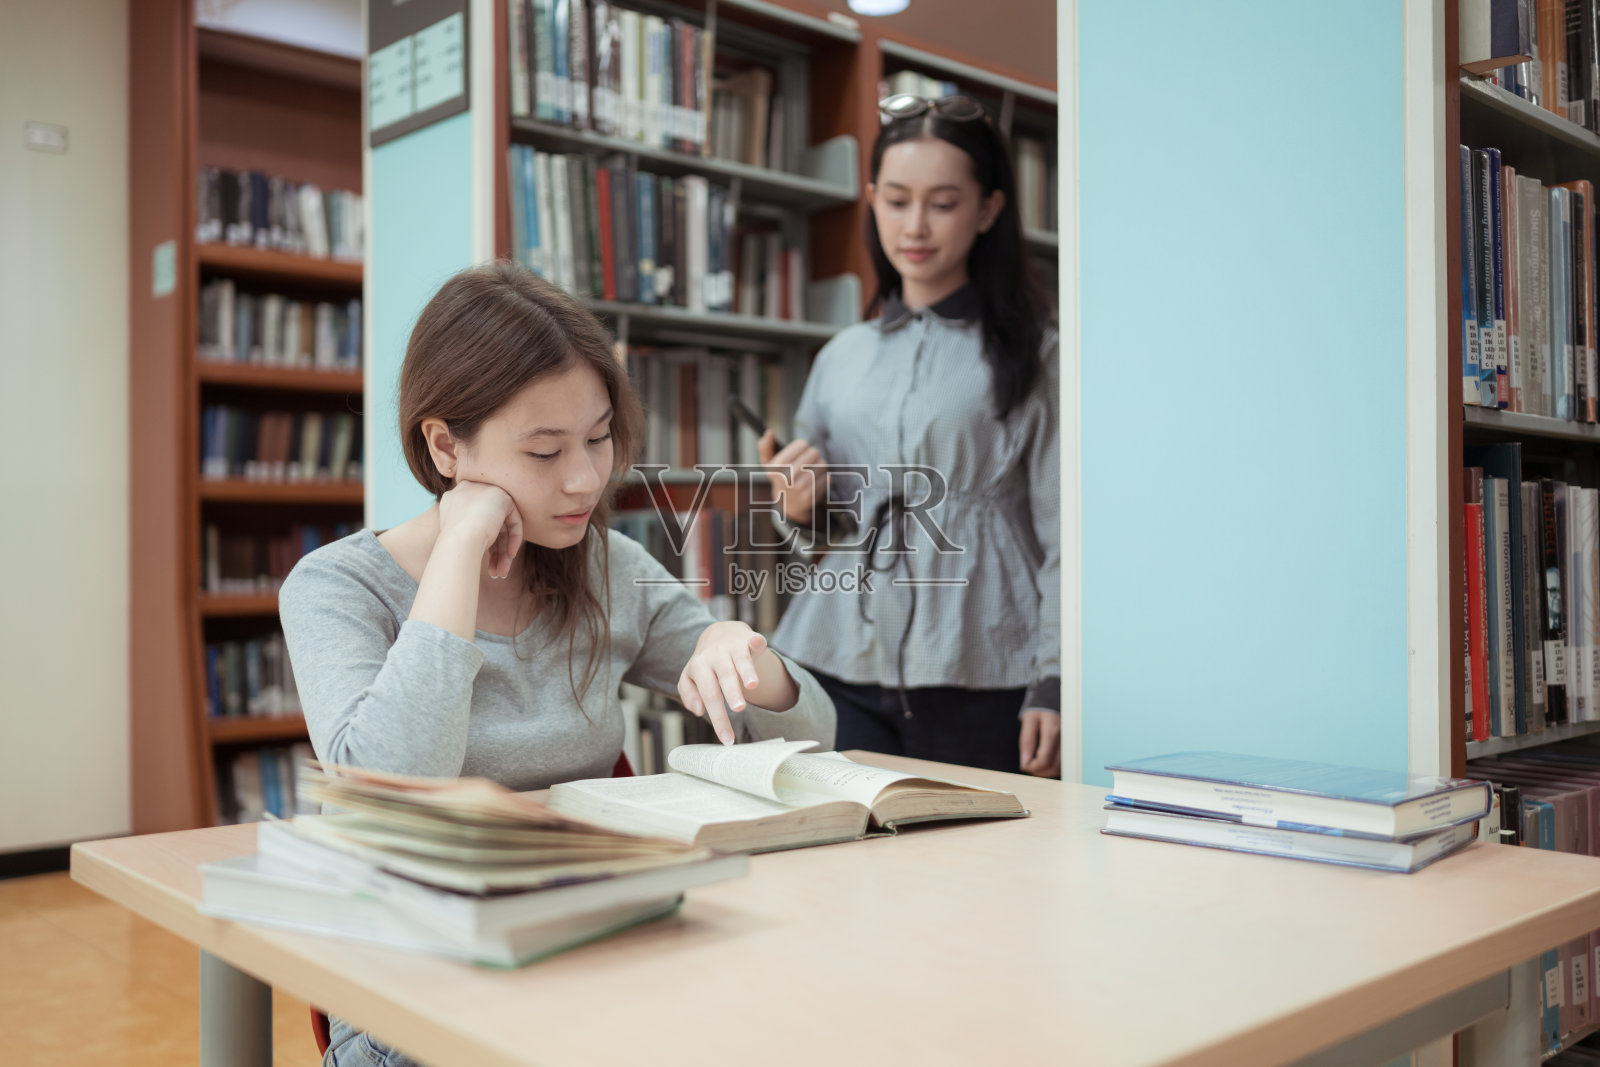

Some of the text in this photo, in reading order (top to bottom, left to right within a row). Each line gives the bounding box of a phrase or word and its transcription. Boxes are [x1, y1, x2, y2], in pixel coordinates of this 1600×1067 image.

[1530, 209, 1541, 277] SIMULATION
[1532, 279, 1541, 303] AND
[1504, 531, 1512, 605] Information
